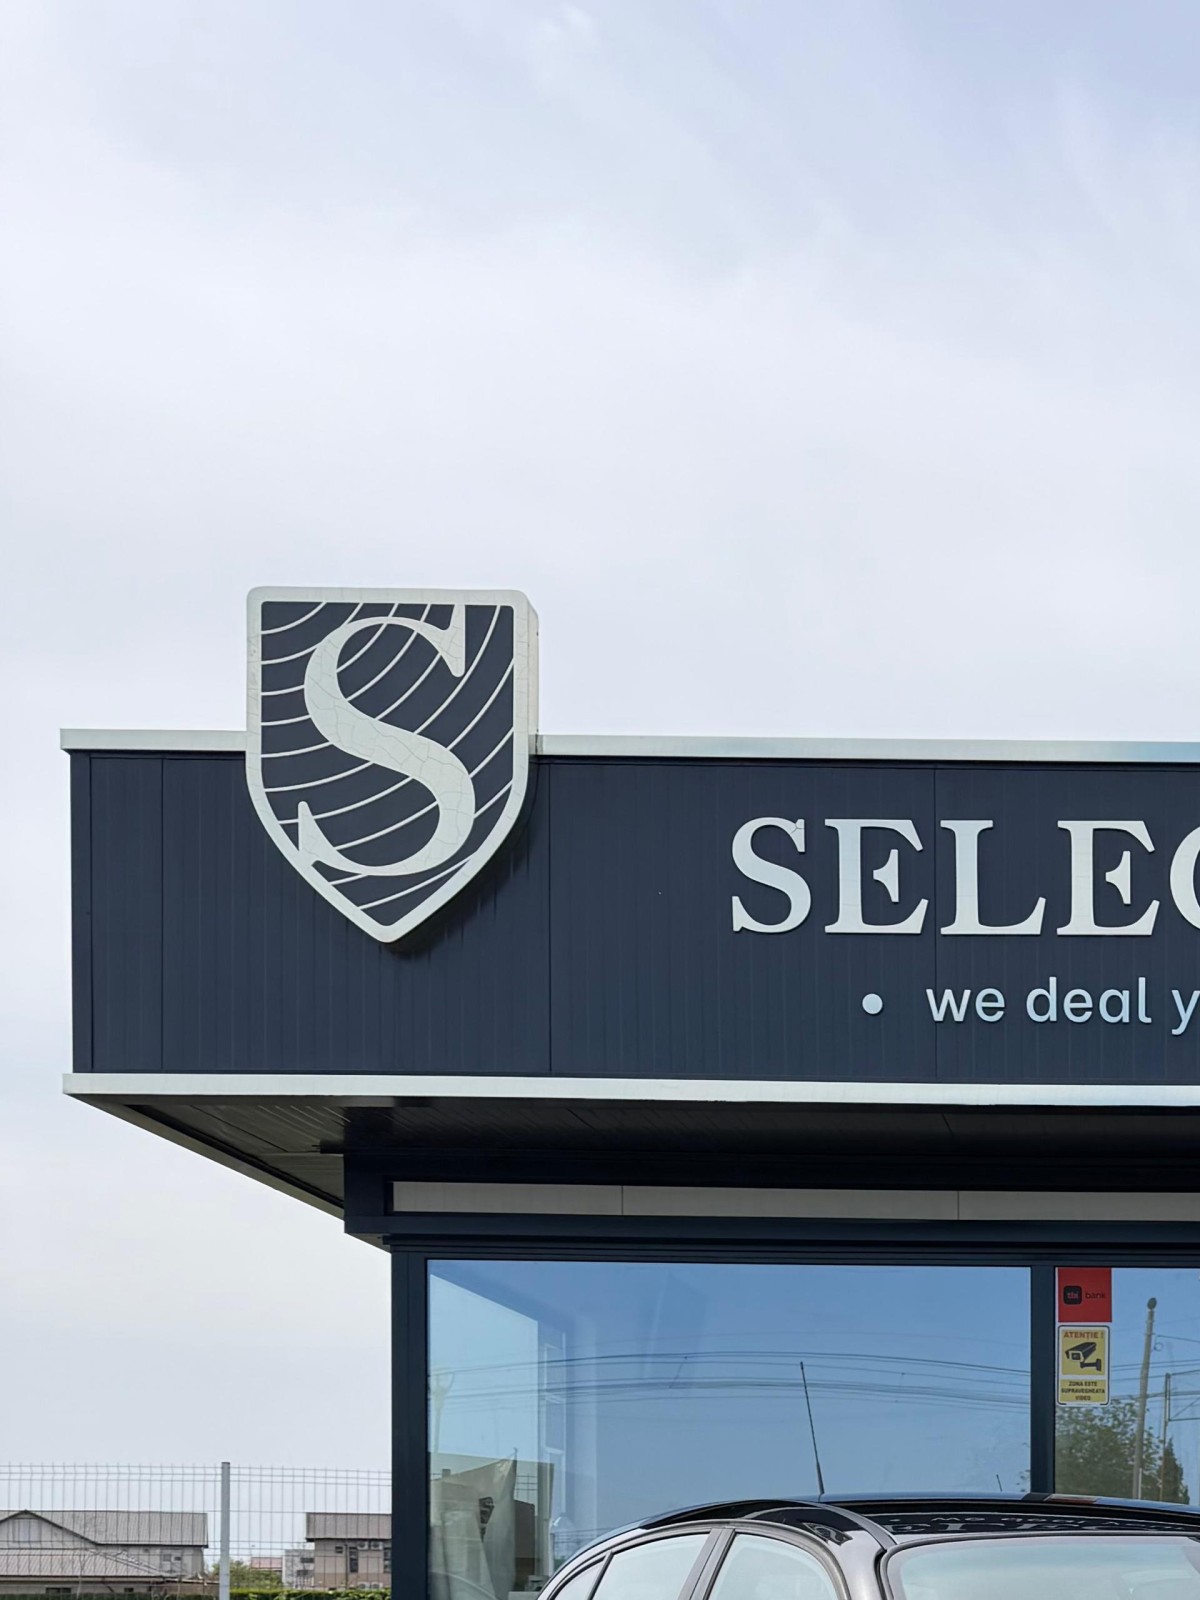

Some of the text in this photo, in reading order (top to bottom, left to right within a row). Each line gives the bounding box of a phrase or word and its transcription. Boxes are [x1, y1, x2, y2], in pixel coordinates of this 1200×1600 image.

[298, 604, 476, 876] S
[926, 987, 1006, 1023] we
[1025, 976, 1152, 1023] deal
